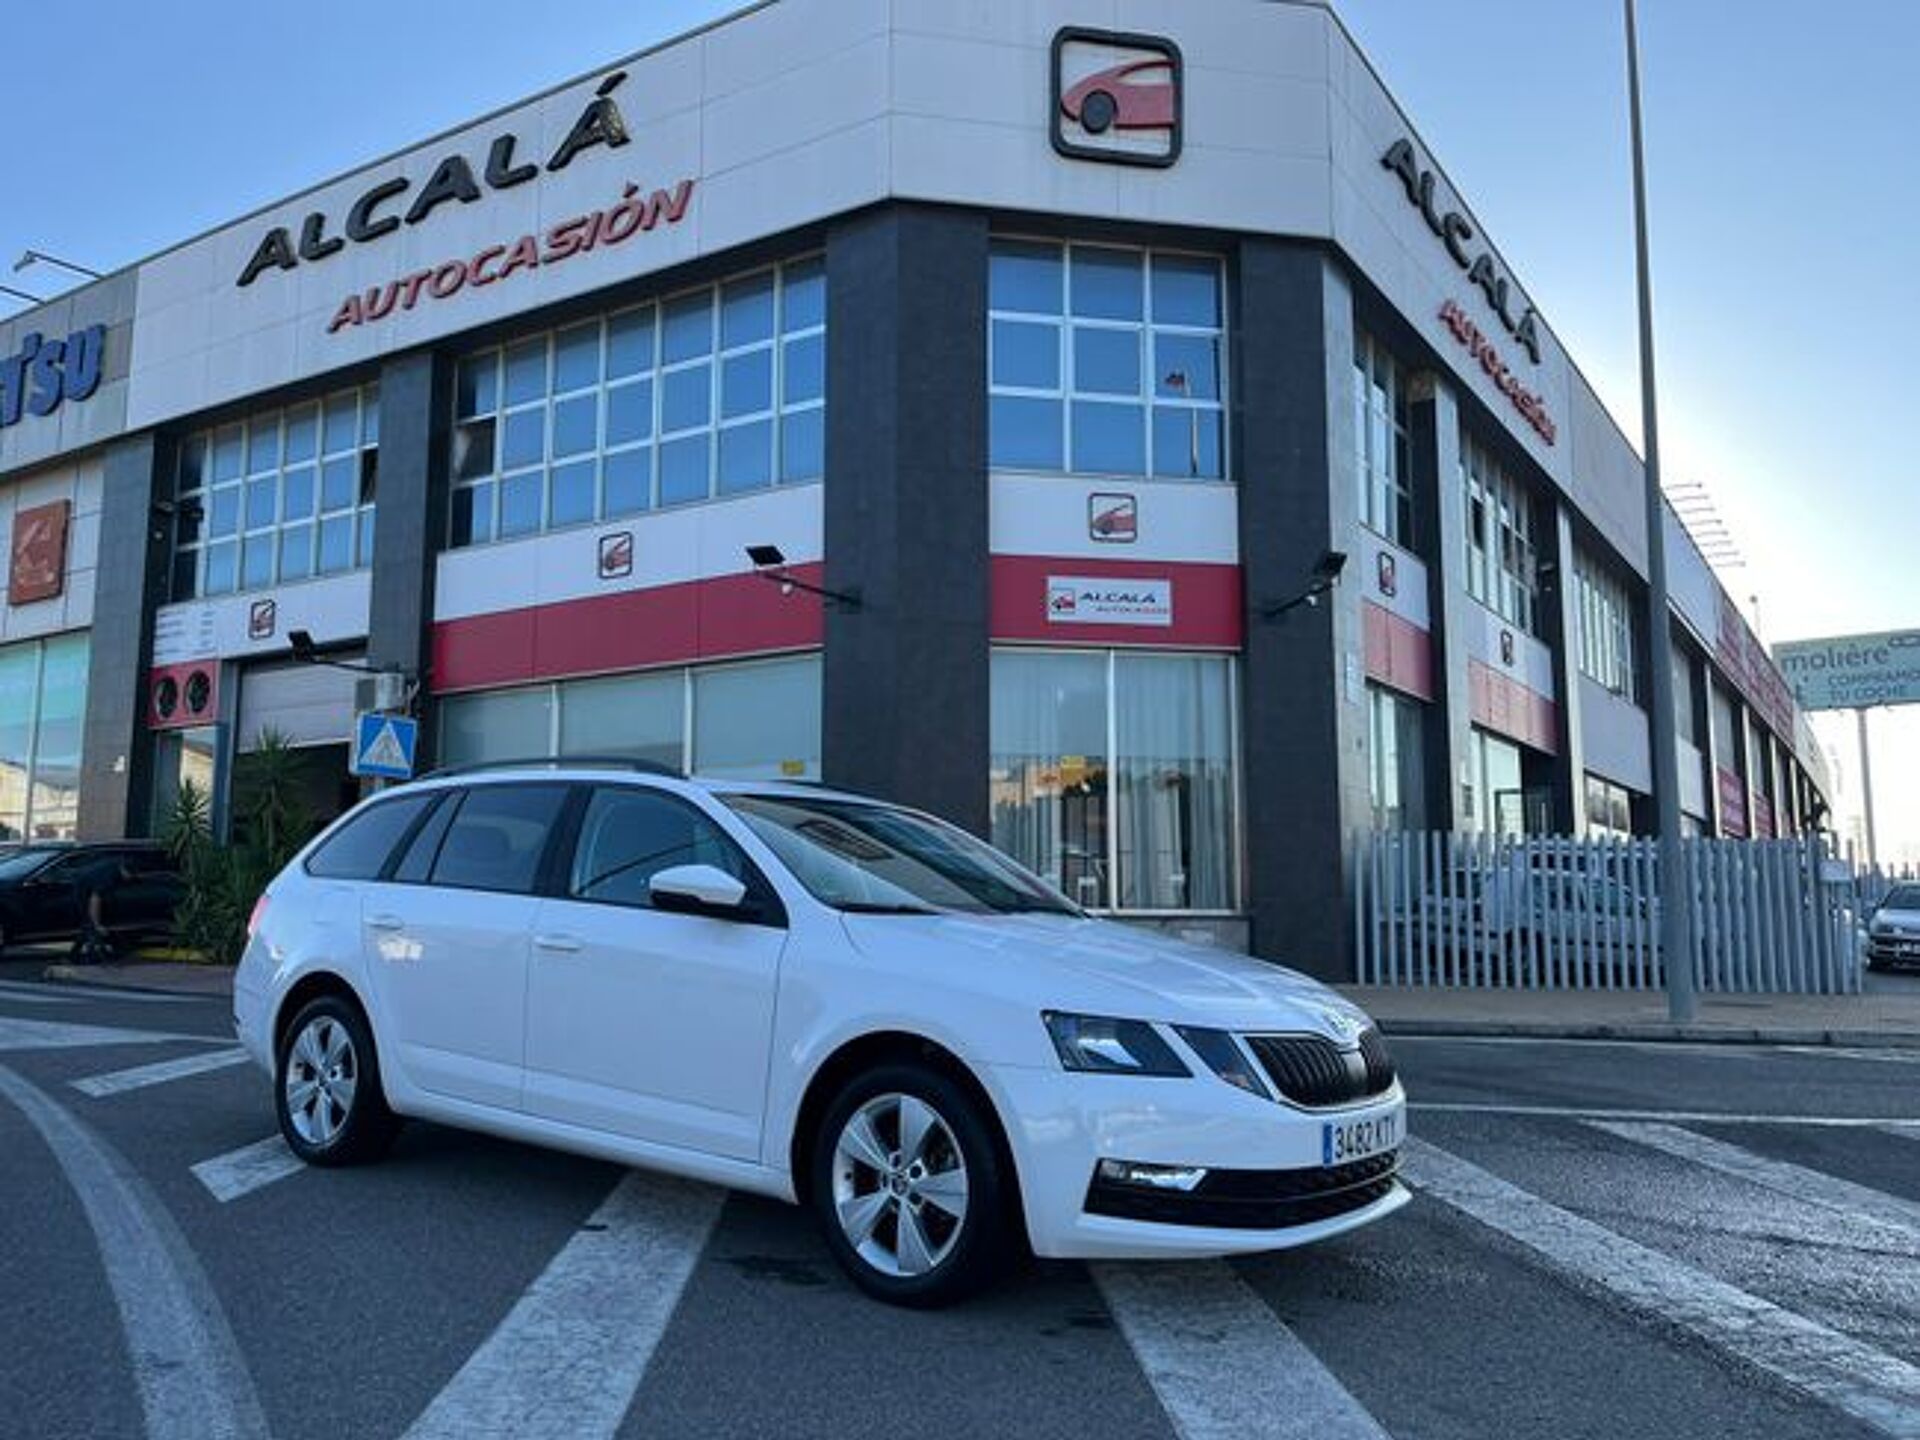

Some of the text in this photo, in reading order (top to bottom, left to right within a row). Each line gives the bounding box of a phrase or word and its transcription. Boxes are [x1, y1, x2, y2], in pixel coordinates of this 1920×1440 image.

[236, 72, 629, 287] ALCALÁ
[328, 180, 695, 333] AUTOCASIÓN
[1380, 138, 1541, 366] ALCALÁ
